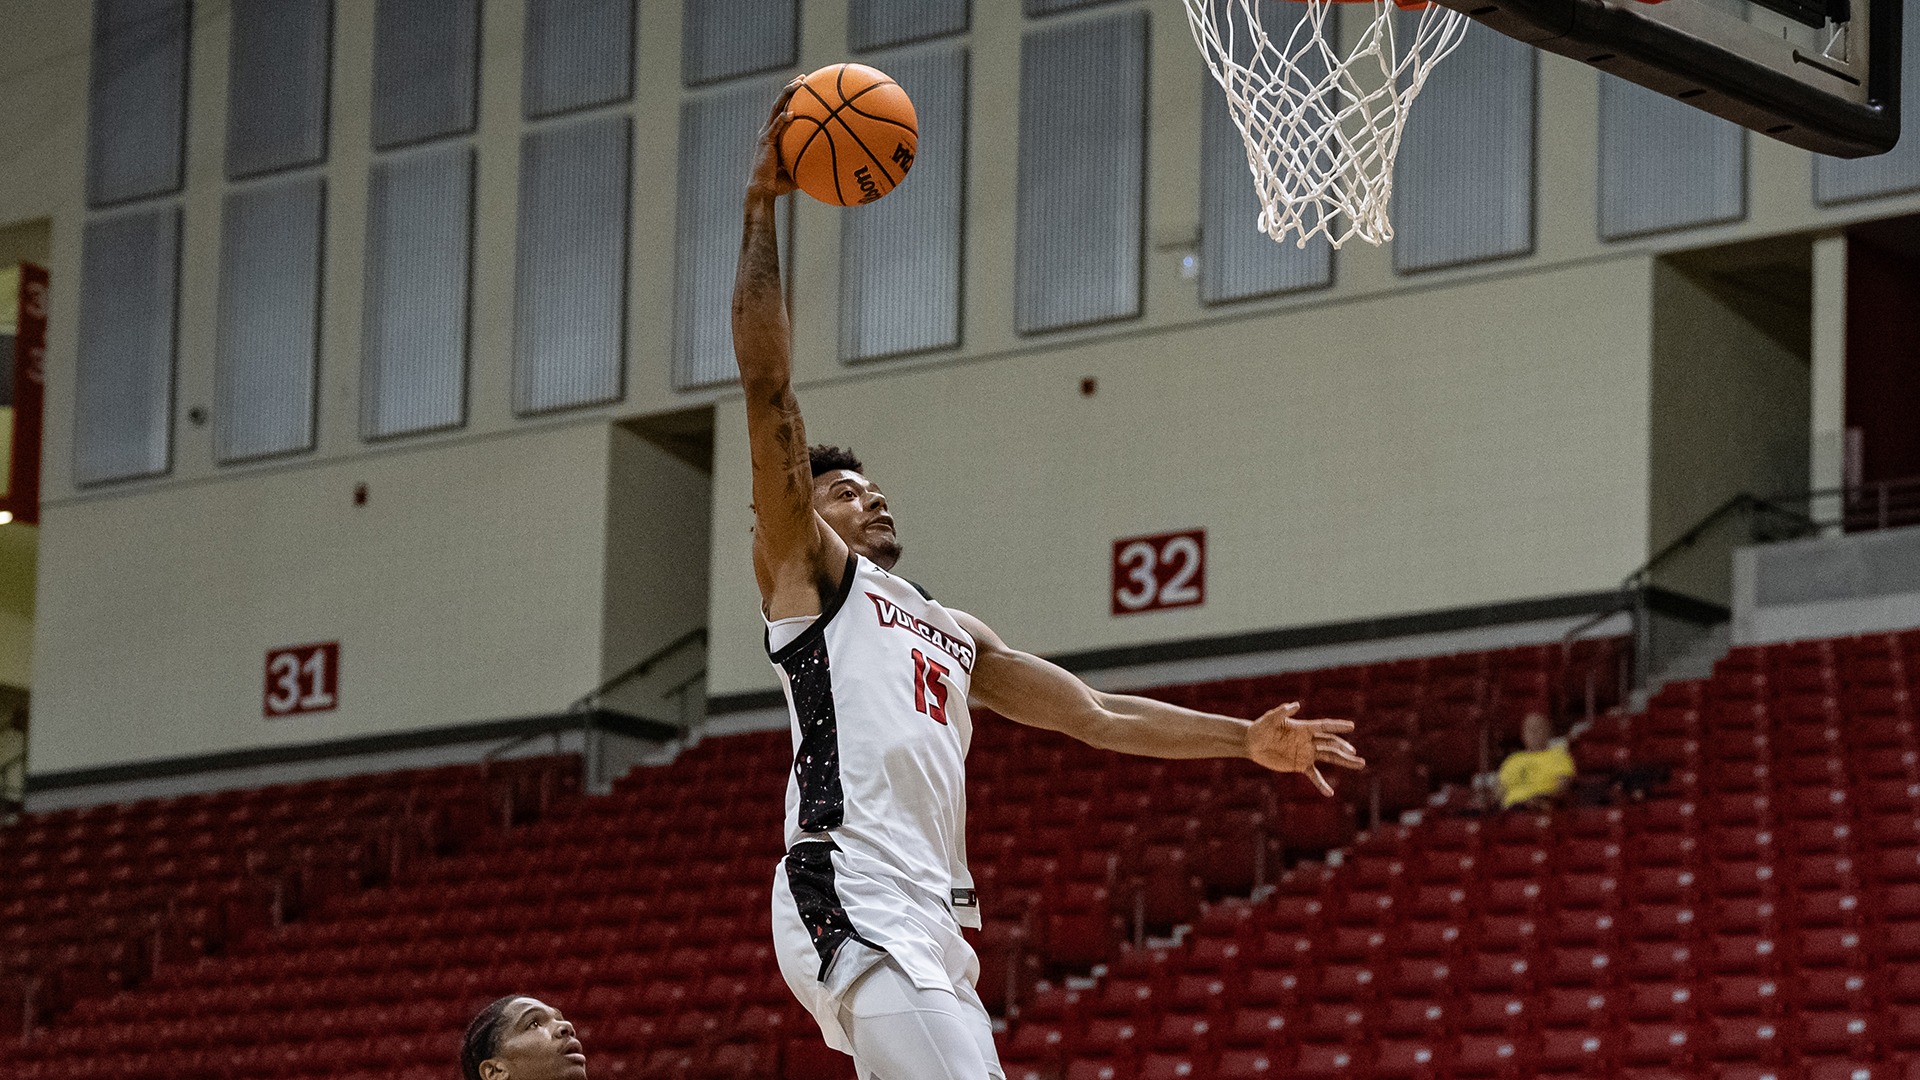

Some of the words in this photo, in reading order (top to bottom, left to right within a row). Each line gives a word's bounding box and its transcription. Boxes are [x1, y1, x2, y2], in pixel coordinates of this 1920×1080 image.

[1118, 537, 1200, 609] 32
[865, 593, 973, 674] VULCANS
[268, 649, 333, 712] 31
[911, 647, 950, 726] 15
